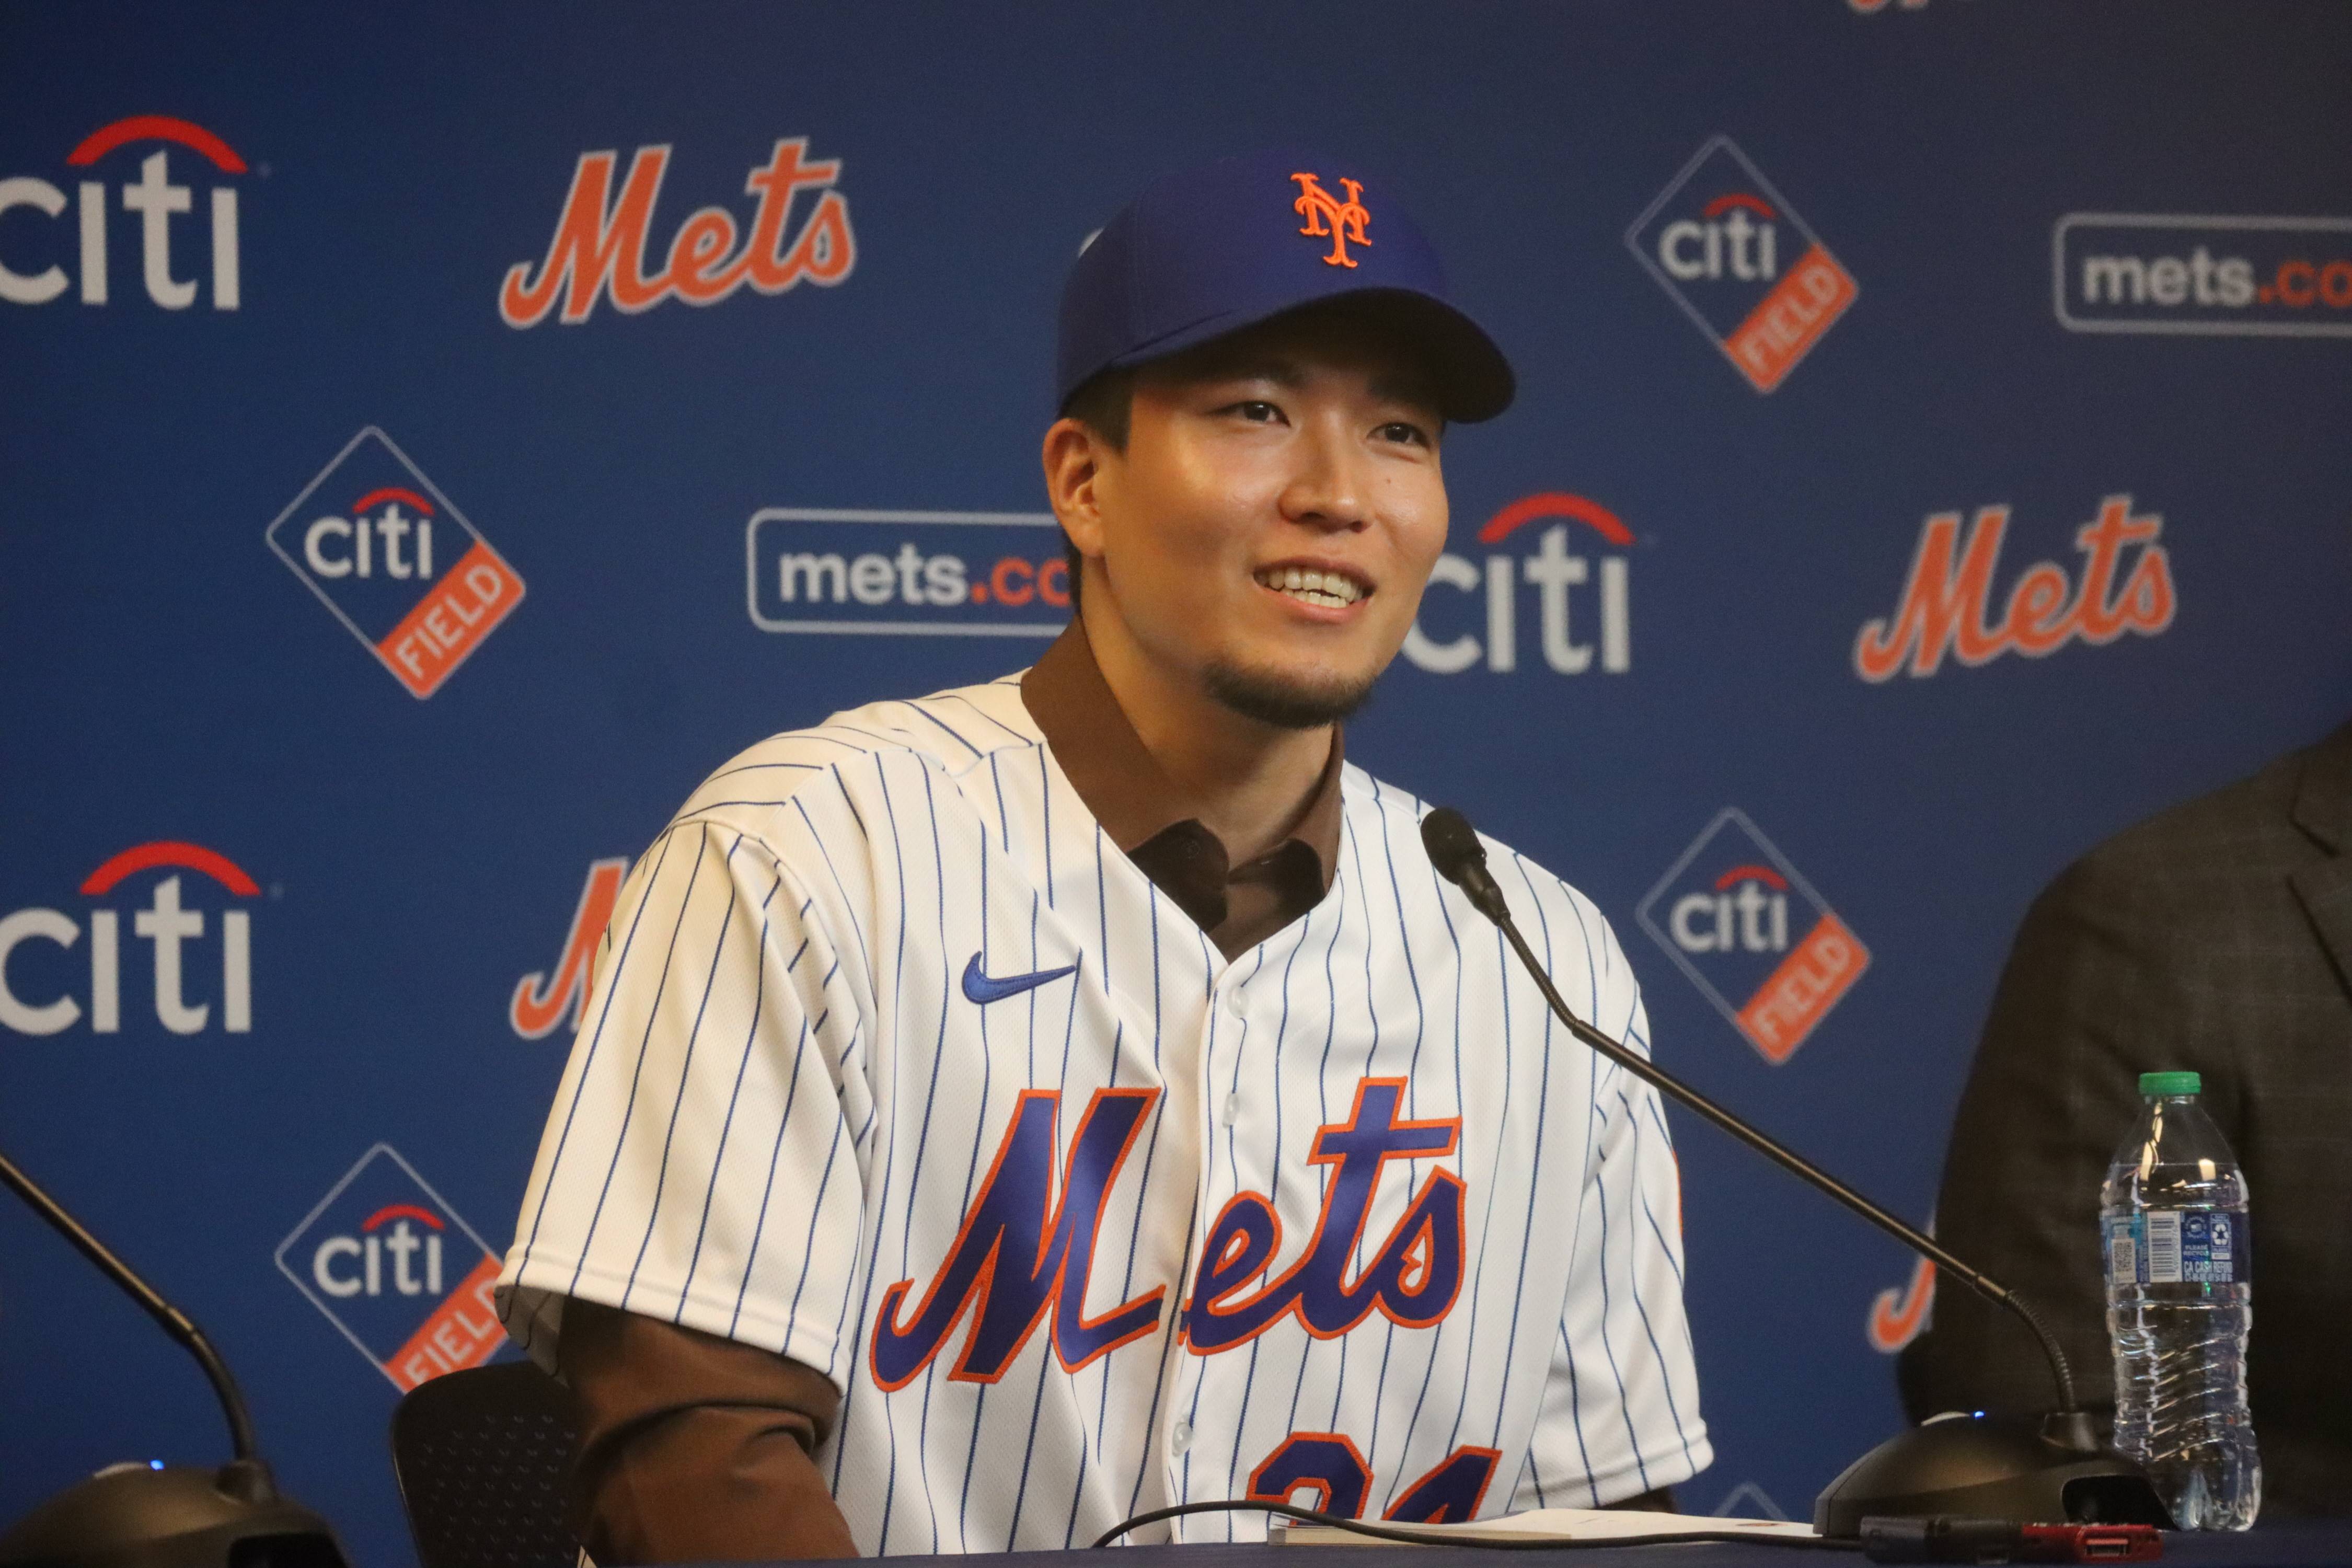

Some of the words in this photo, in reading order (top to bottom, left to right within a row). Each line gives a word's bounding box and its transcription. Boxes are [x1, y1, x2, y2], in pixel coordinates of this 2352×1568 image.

[0, 149, 240, 310] citi
[499, 136, 856, 330] Mets
[1658, 207, 1777, 281] citi
[1742, 266, 1839, 372] FIELD
[304, 503, 434, 579] citi
[1401, 523, 1631, 675] citi
[1852, 493, 2176, 683] Mets
[394, 563, 503, 681] FIELD
[0, 874, 253, 1036] citi
[1670, 880, 1789, 952] citi
[1753, 937, 1850, 1046] FIELD
[314, 1220, 443, 1297] citi
[869, 1076, 1468, 1392] Mets
